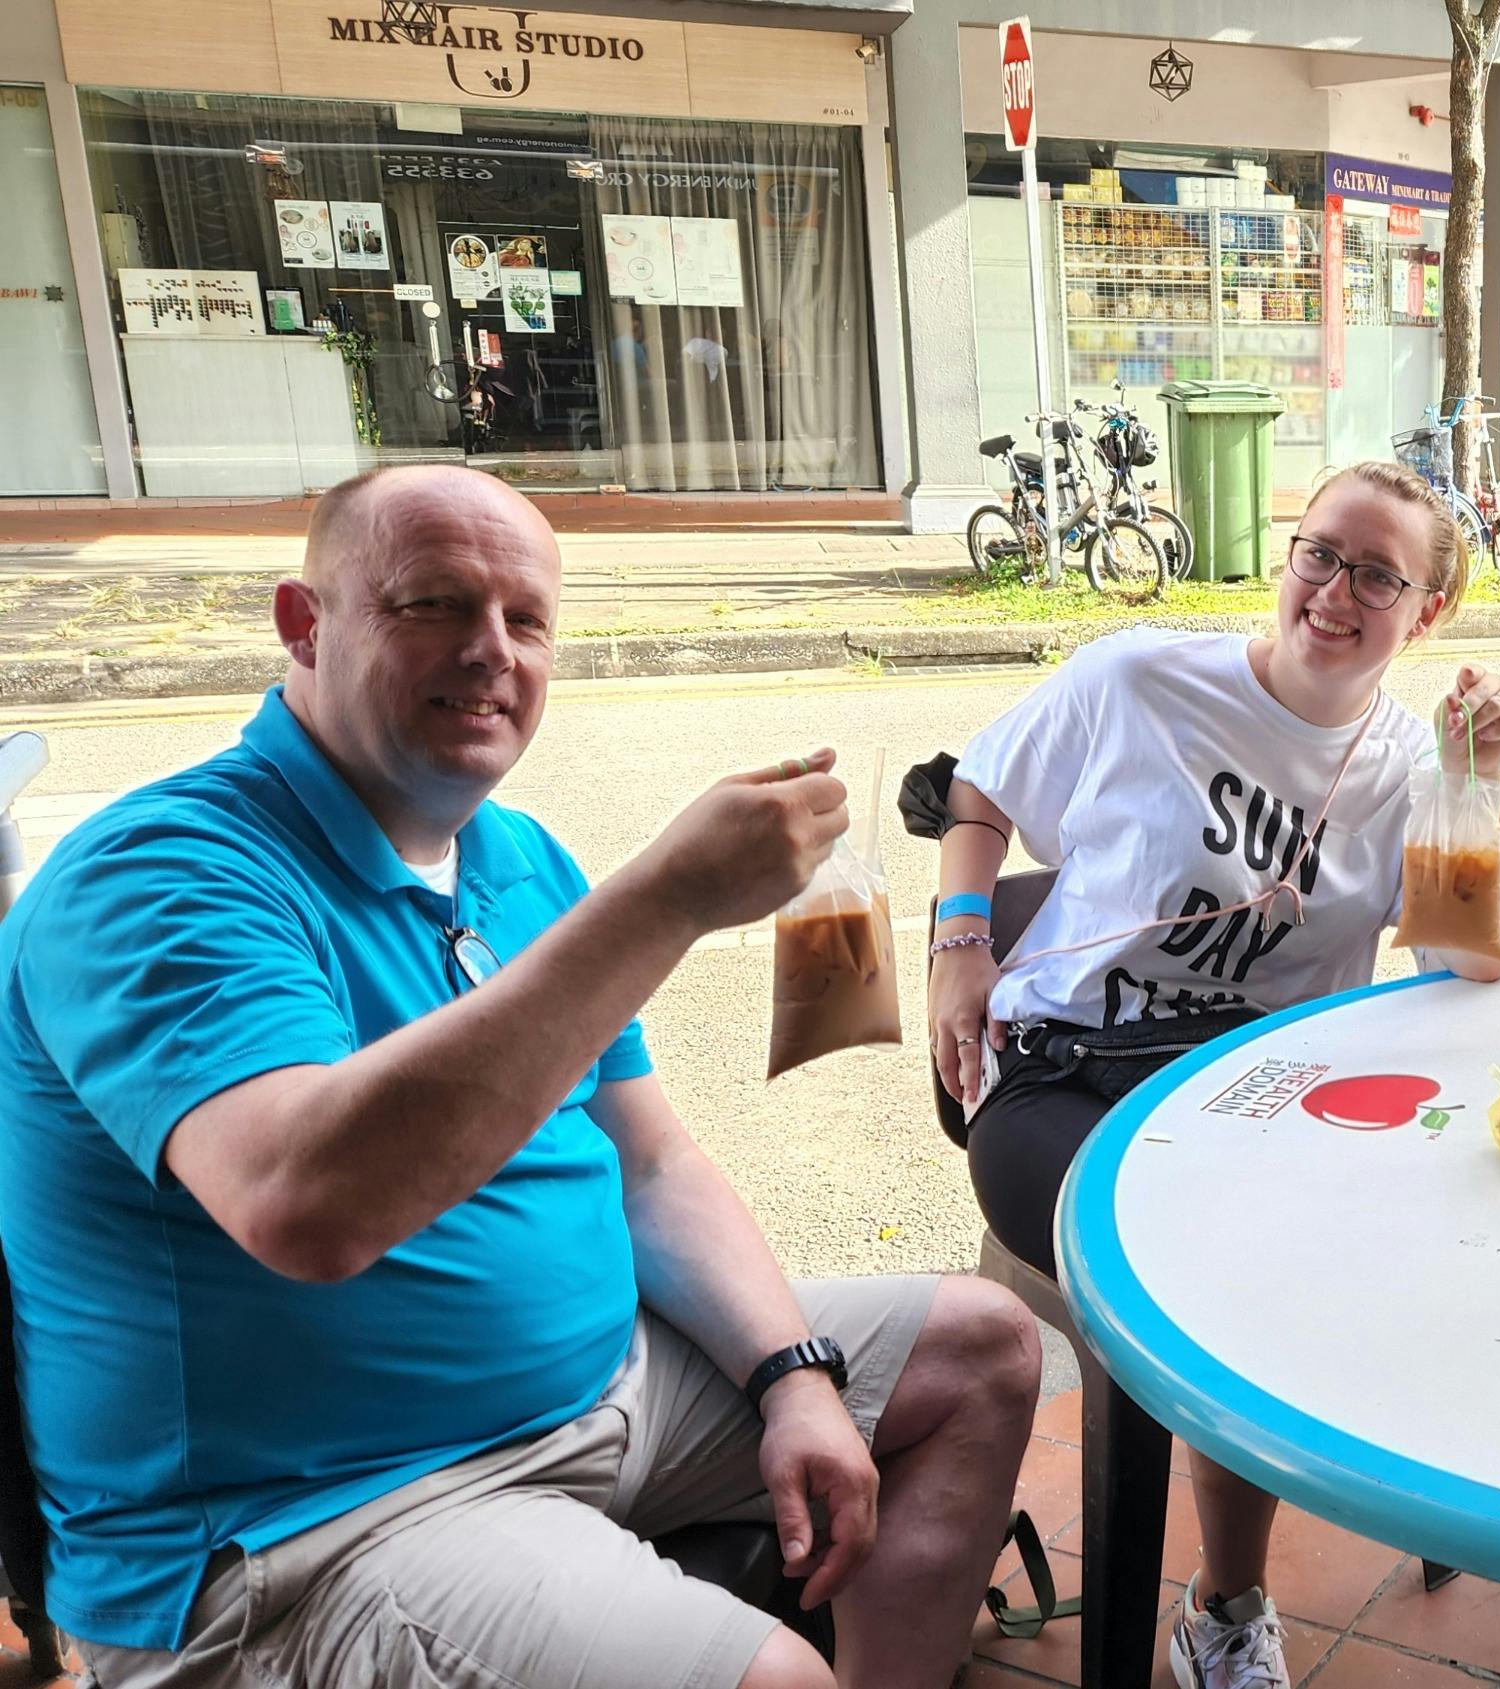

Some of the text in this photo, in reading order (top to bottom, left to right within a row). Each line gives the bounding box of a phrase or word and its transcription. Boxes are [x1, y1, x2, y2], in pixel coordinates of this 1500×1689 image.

[516, 30, 645, 61] STUDIO
[1004, 60, 1031, 110] STOP
[1333, 168, 1390, 195] GATEWAY
[1391, 184, 1425, 200] MINIMART
[1425, 189, 1430, 201] &
[396, 288, 431, 297] CLOSED
[1203, 771, 1328, 896] SUN
[1158, 887, 1293, 983] DAY
[1208, 1066, 1284, 1116] DOMAIN
[1238, 1069, 1317, 1120] HEALTH
